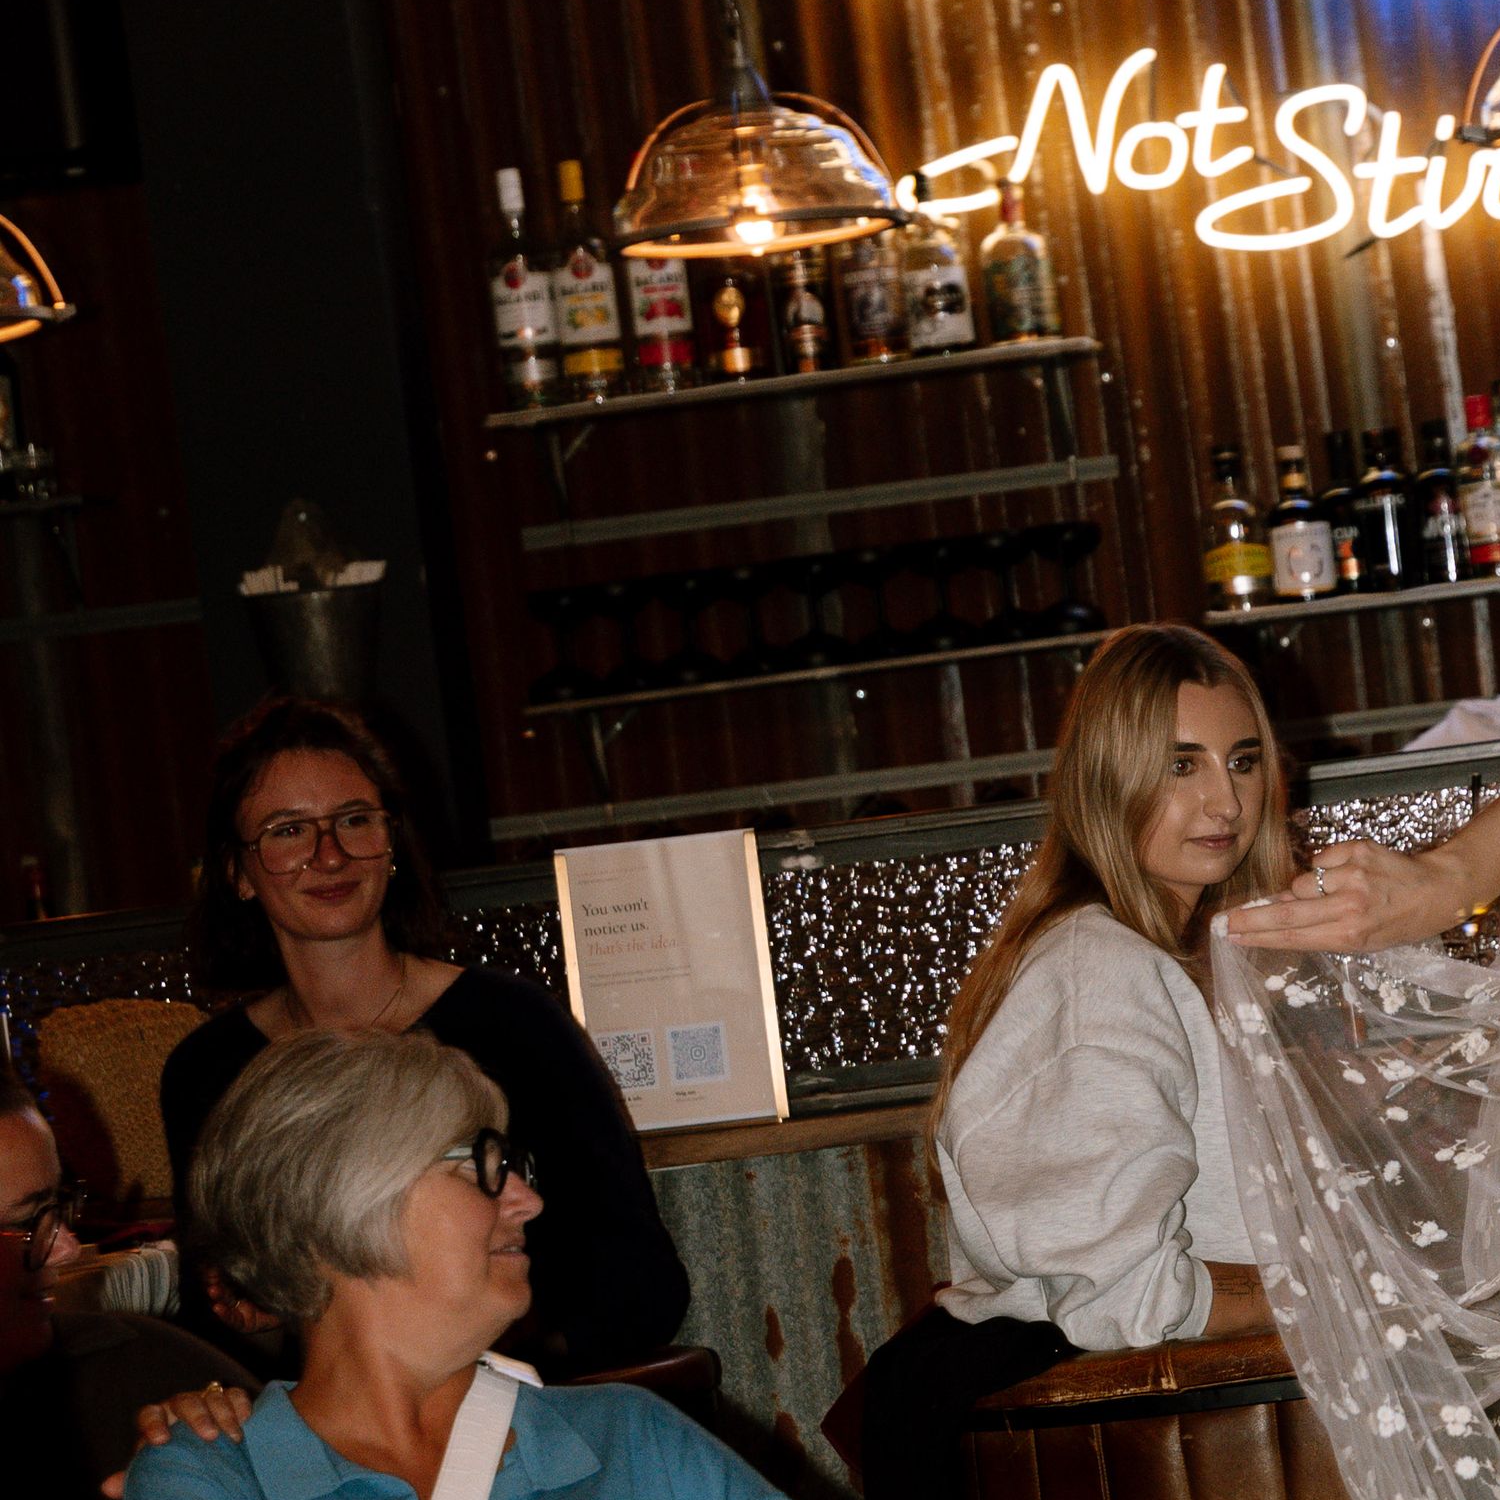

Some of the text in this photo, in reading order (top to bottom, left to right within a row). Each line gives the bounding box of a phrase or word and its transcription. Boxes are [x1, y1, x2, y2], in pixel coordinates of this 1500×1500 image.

[896, 48, 1256, 214] Not
[582, 898, 649, 917] You won't
[584, 921, 649, 937] notice us.
